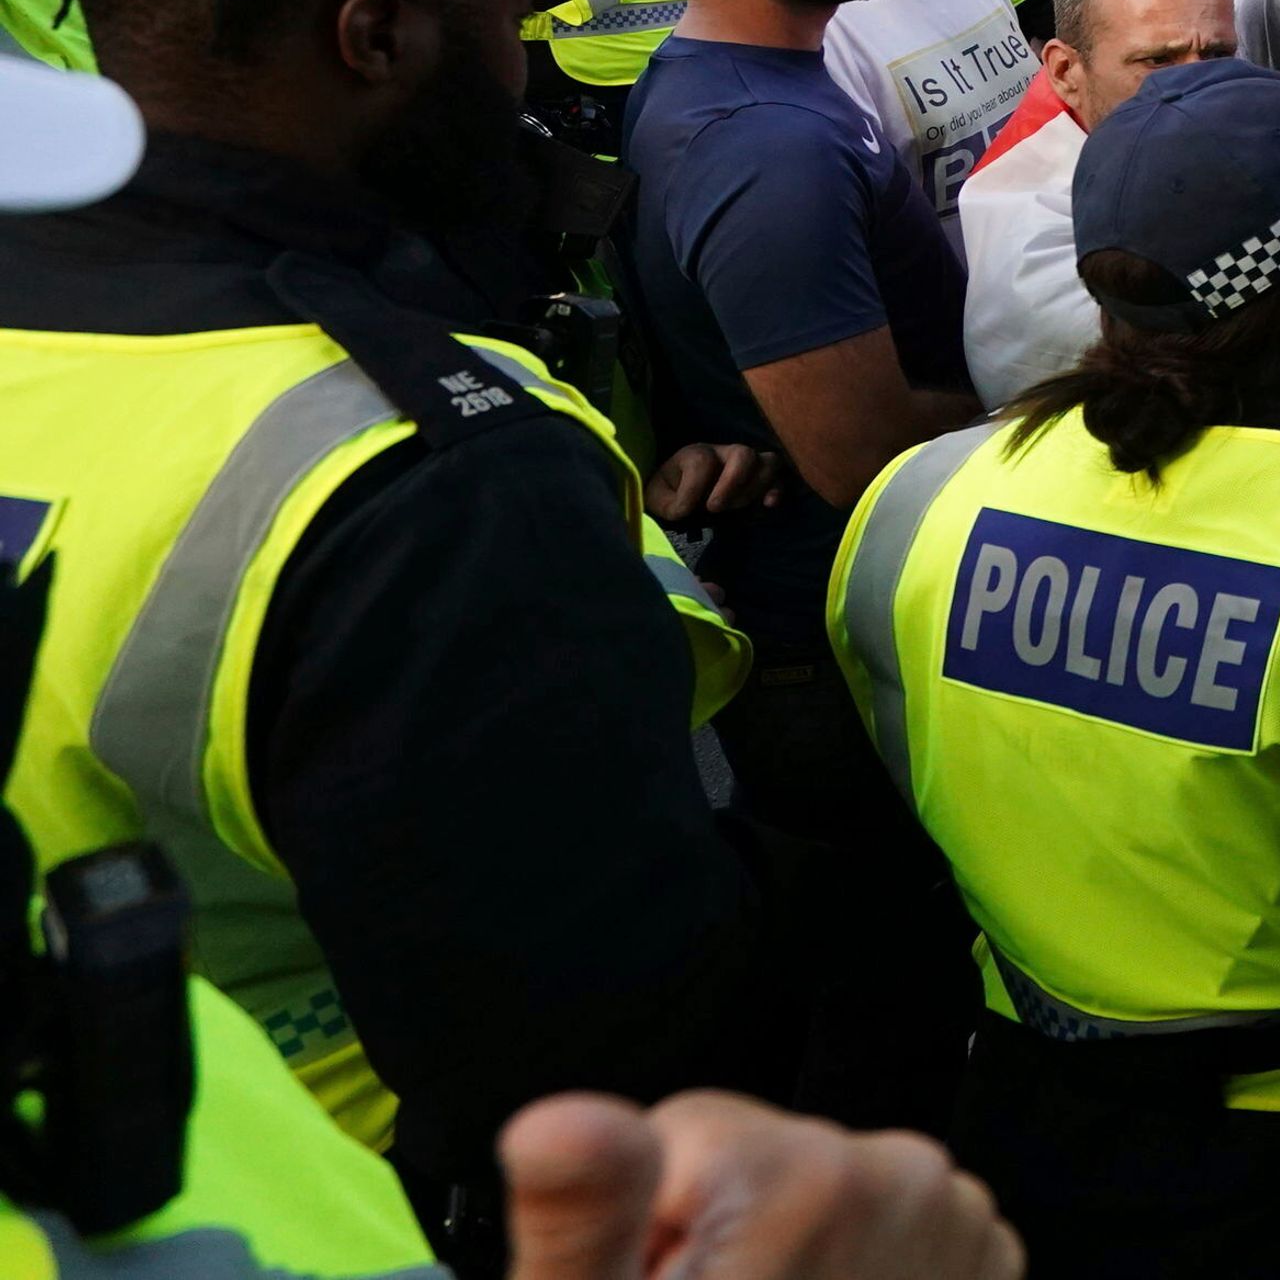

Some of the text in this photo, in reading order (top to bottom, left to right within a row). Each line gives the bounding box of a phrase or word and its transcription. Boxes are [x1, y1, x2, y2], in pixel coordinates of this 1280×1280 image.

[904, 21, 1028, 114] Is It True
[926, 124, 945, 141] Or
[950, 113, 967, 132] did
[967, 108, 982, 126] you
[998, 83, 1025, 106] about
[438, 370, 484, 395] NE
[961, 543, 1260, 711] POLICE
